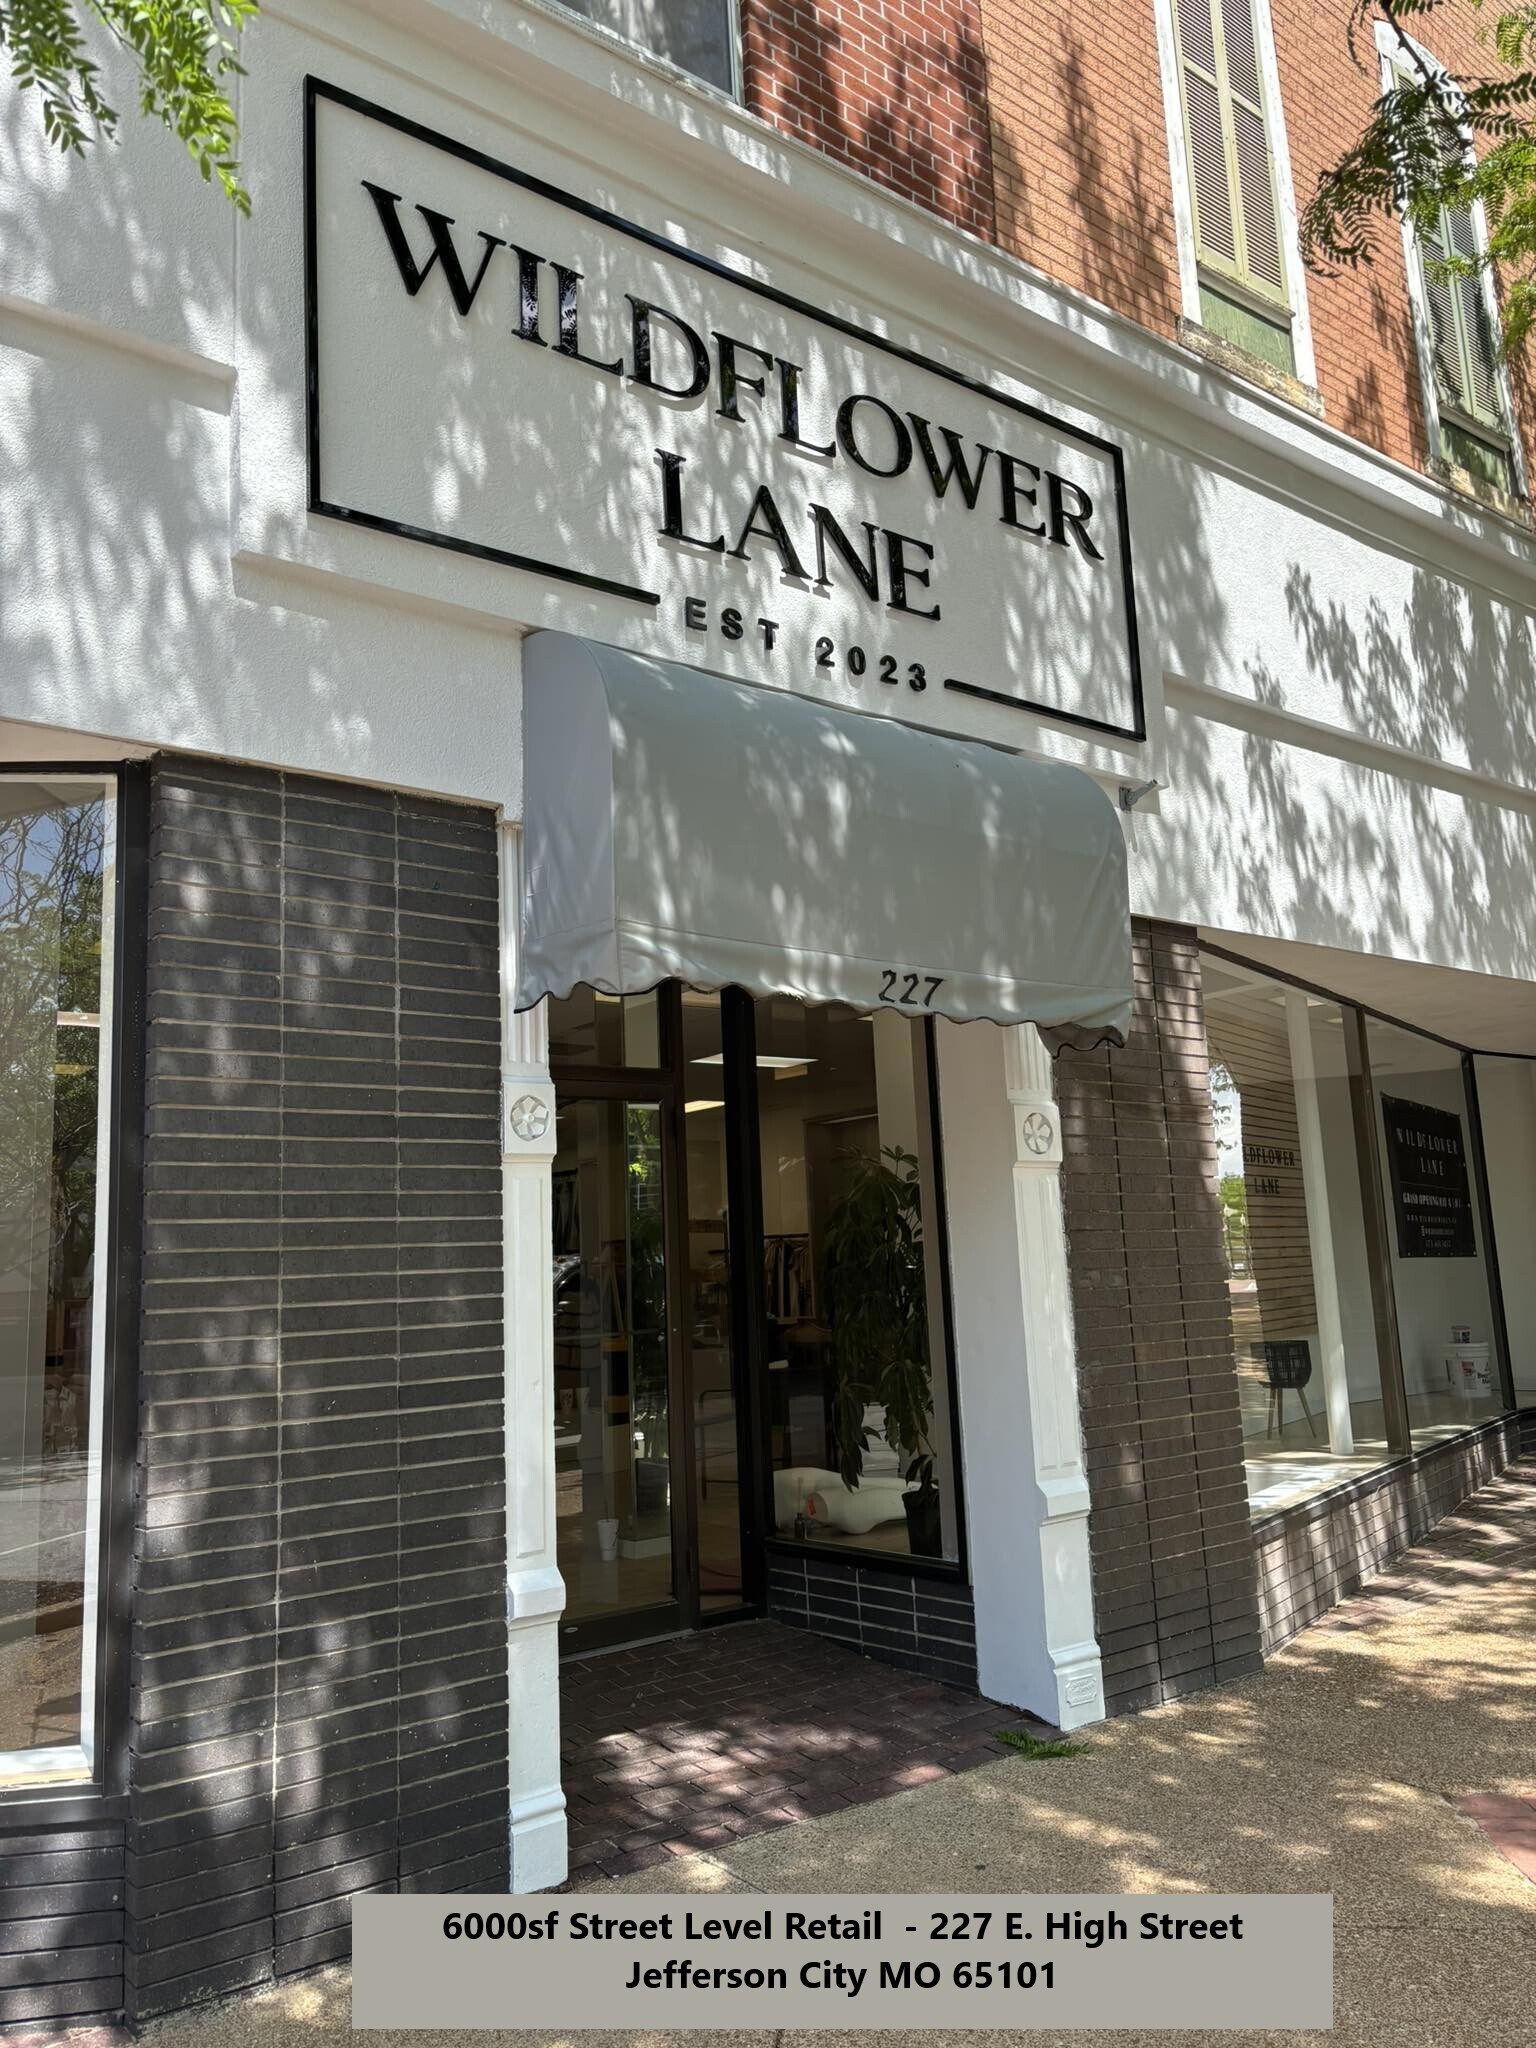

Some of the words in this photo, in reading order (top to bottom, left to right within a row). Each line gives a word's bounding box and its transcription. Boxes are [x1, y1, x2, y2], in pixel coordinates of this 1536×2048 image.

[361, 180, 1105, 561] WILDFLOWER
[654, 447, 941, 621] LANE
[685, 597, 780, 651] EST
[814, 636, 928, 692] 2023
[879, 969, 945, 1007] 227
[1243, 1146, 1295, 1166] LDFLOWER
[1420, 1156, 1445, 1176] LANE
[1254, 1177, 1280, 1194] LANE
